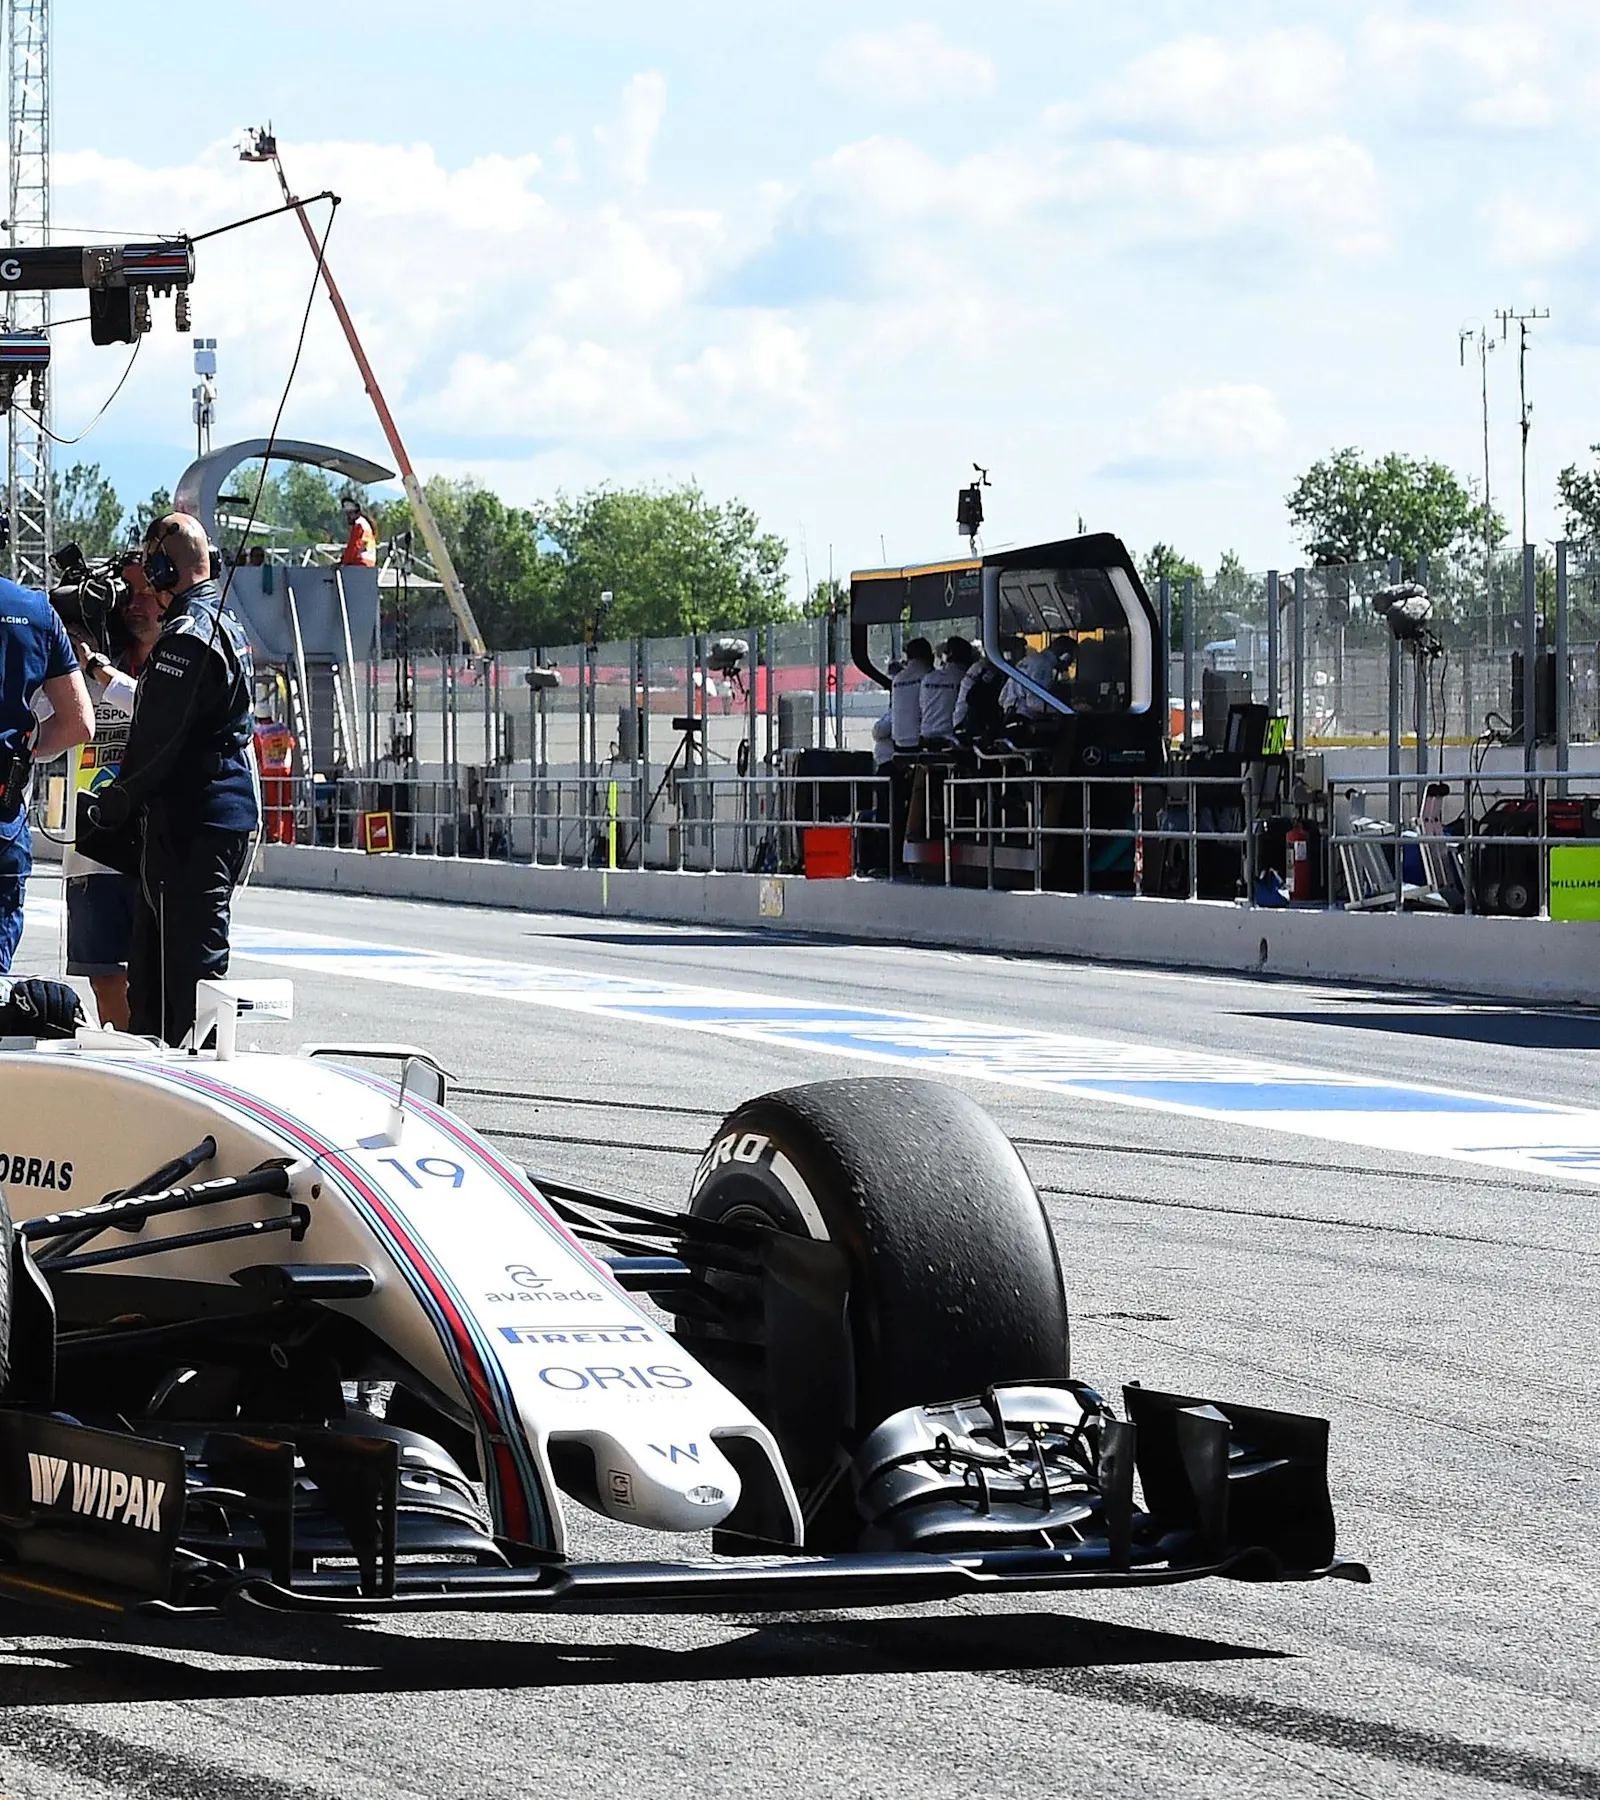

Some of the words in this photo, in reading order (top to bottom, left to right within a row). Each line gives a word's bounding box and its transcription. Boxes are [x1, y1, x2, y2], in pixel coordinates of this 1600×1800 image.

[377, 1157, 466, 1190] 19
[691, 1132, 771, 1208] ERO
[484, 1289, 605, 1303] avanade
[496, 1324, 655, 1344] PIRELLI
[538, 1365, 694, 1391] ORIS
[71, 1461, 167, 1532] WIPAK
